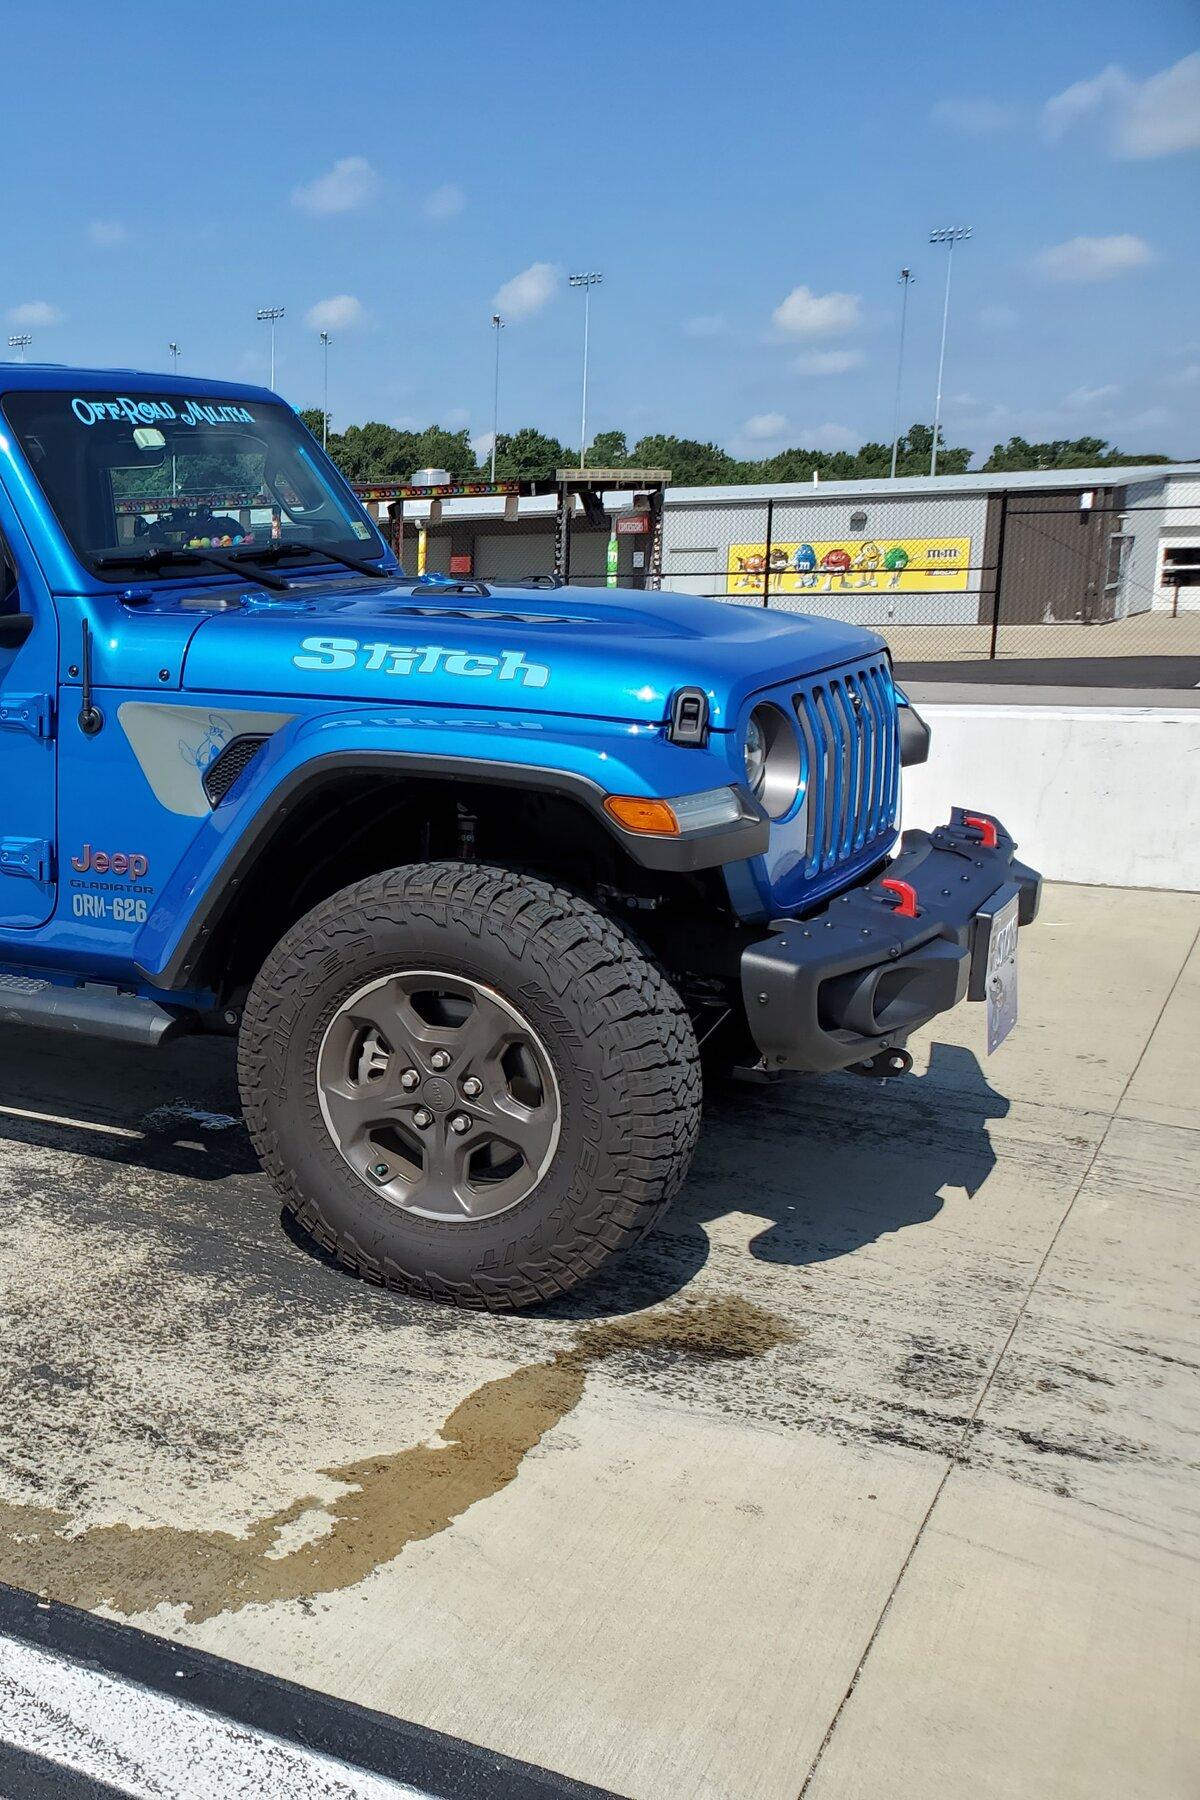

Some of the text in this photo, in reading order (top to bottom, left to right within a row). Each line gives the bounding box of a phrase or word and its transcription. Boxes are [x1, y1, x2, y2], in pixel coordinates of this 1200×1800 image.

[293, 636, 552, 688] Stitch
[71, 844, 149, 882] Jeep
[69, 879, 155, 895] GLADIATOR
[72, 893, 148, 922] ORM-626
